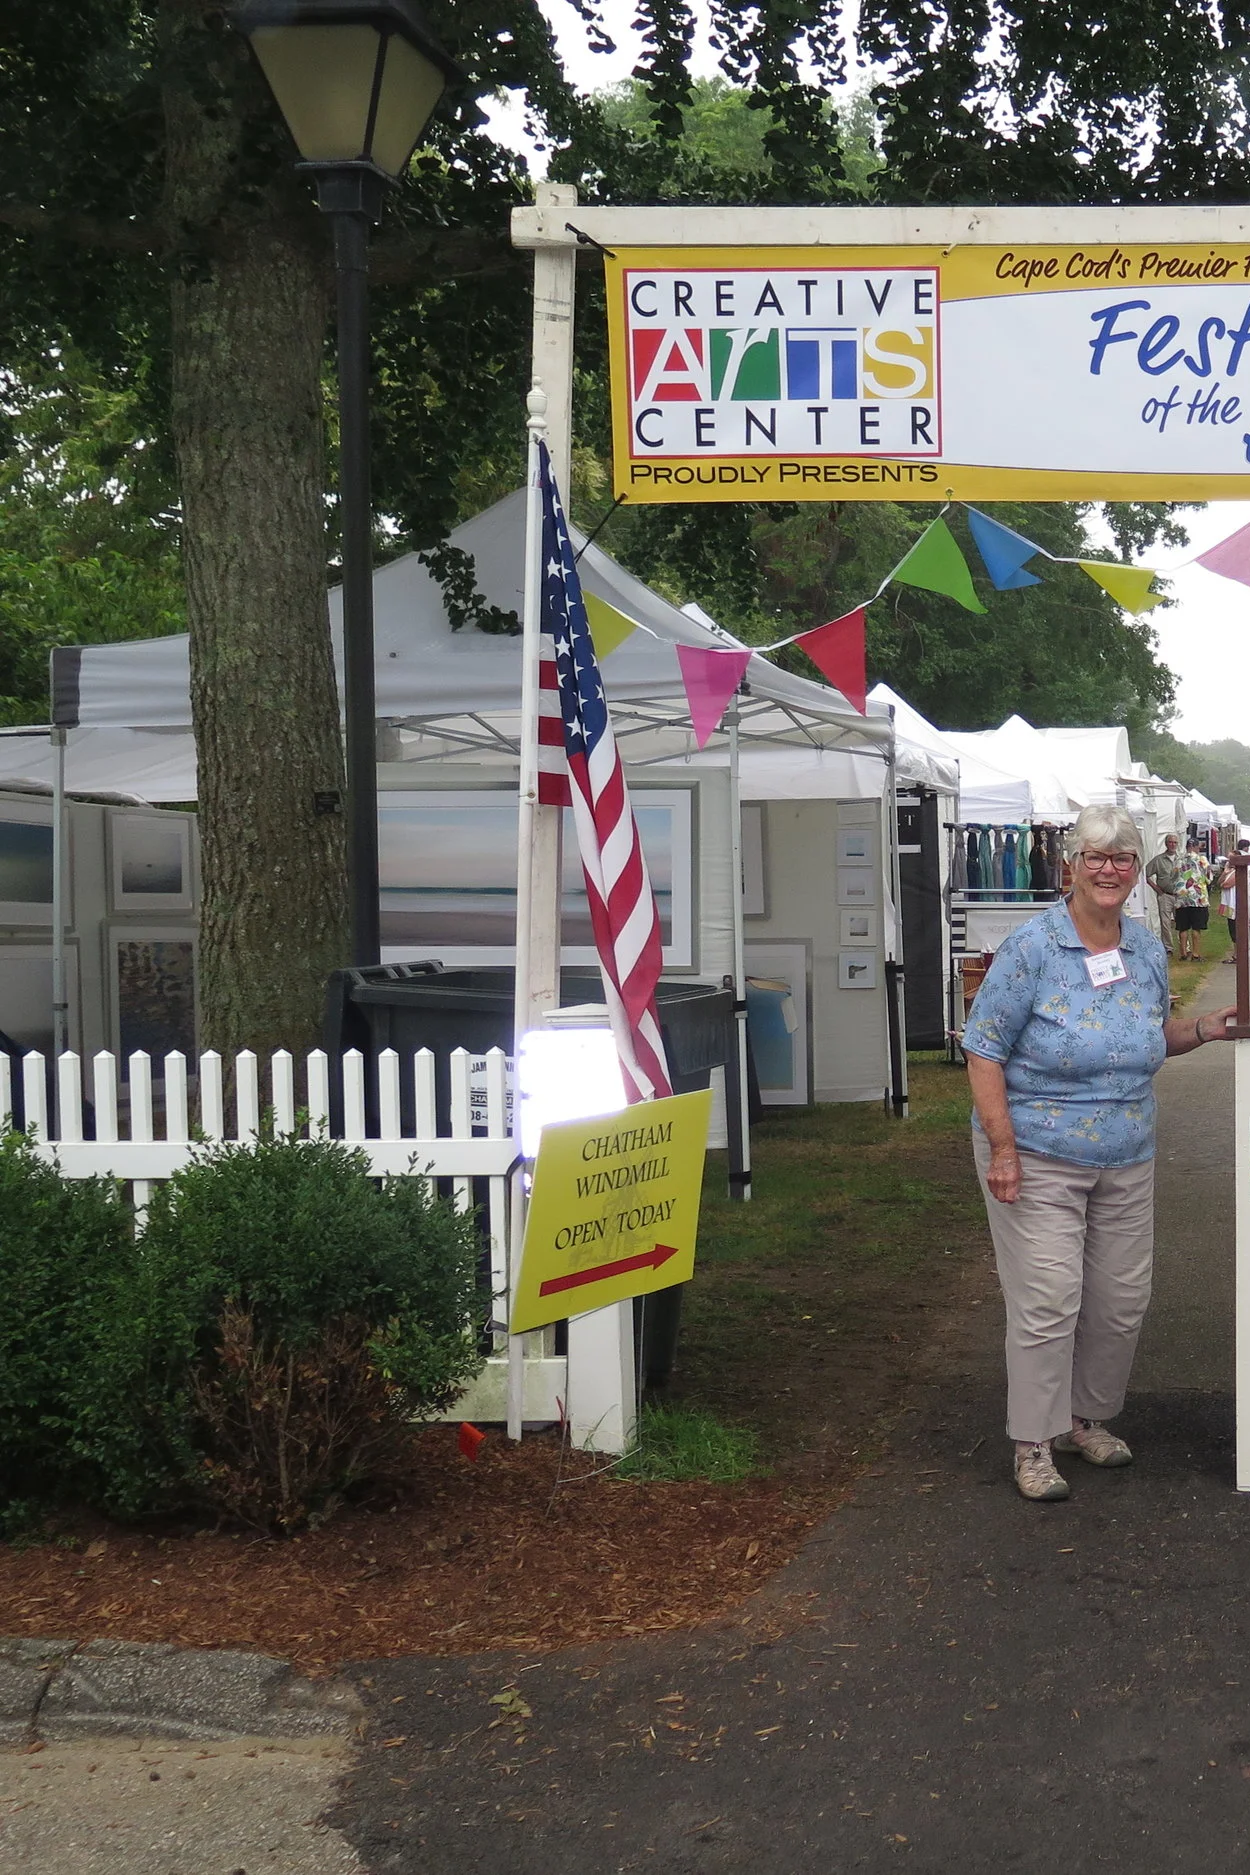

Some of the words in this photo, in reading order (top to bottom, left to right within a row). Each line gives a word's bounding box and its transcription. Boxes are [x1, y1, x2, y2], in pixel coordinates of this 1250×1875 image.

[995, 252, 1060, 288] Cape
[1065, 249, 1131, 279] Cod's
[1138, 251, 1238, 279] Premier
[630, 278, 934, 317] CREATIVE
[635, 406, 934, 447] CENTER
[1142, 385, 1183, 433] of
[1186, 382, 1243, 425] the
[630, 464, 771, 484] PROUDLY
[779, 463, 938, 483] PRESENTS
[582, 1121, 673, 1162] CHATHAM
[576, 1157, 670, 1199] WINDMILL
[555, 1217, 608, 1250] OPEN
[616, 1198, 677, 1234] TODAY
